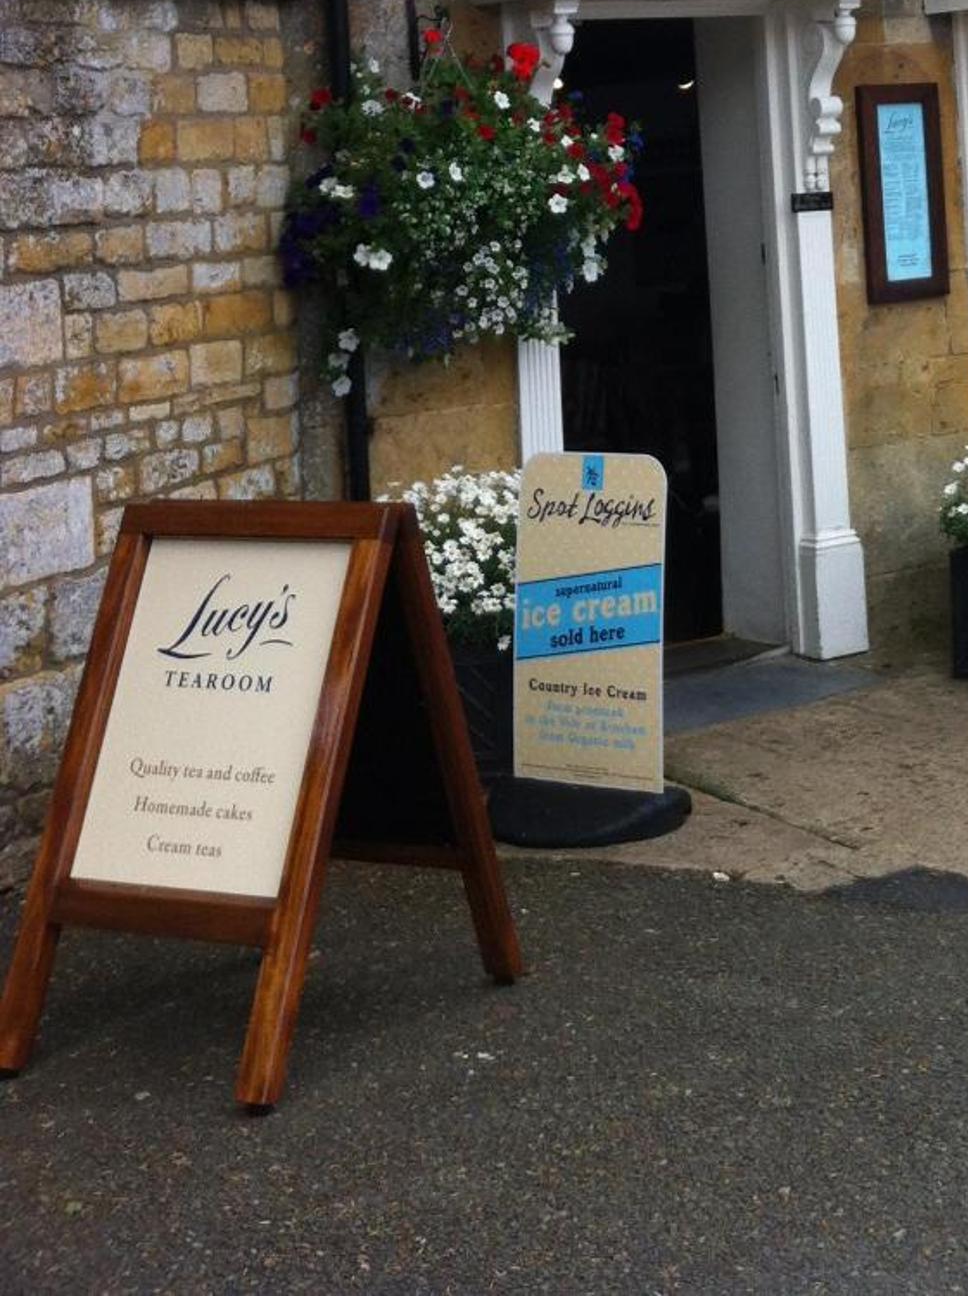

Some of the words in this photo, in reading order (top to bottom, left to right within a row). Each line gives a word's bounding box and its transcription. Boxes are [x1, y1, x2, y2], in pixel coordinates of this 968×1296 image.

[526, 488, 580, 523] Spot
[578, 492, 657, 528] Loggins
[554, 576, 623, 599] supernatural
[157, 573, 296, 661] Lucy's
[522, 599, 562, 630] ice
[571, 590, 658, 623] cream
[549, 627, 584, 649] sold
[589, 625, 626, 644] here
[164, 670, 275, 694] TEAROOM
[528, 678, 579, 697] Country
[582, 682, 602, 696] Ice
[606, 685, 648, 702] Cream
[130, 757, 181, 783] Quality
[182, 764, 204, 779] tea
[205, 764, 233, 781] and
[234, 766, 277, 785] coffee
[133, 795, 213, 819] Homemade
[215, 804, 253, 822] cakes
[146, 833, 192, 856] Cream
[194, 843, 223, 859] teas
